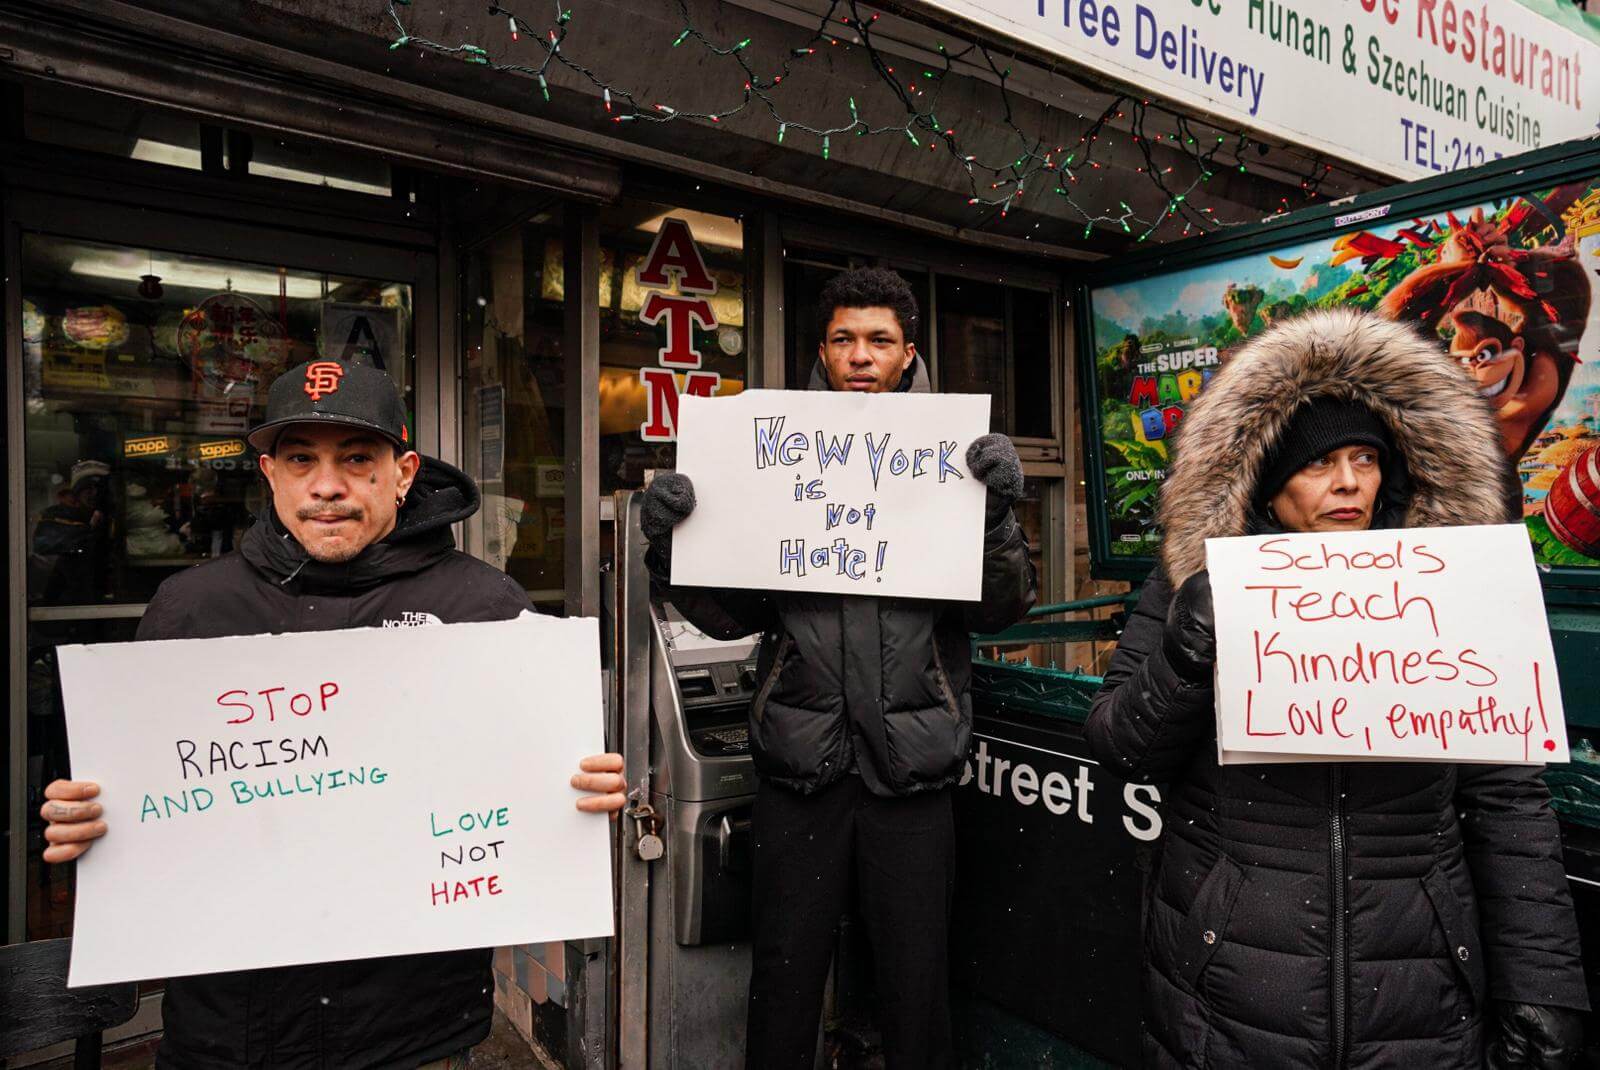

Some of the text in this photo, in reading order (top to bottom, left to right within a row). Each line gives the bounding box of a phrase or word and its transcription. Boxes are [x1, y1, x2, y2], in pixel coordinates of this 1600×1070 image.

[1037, 0, 1264, 116] ree Delivery
[1248, 0, 1541, 148] Hunan & Szechuan Cuisine
[1417, 0, 1581, 110] Restaurant
[341, 316, 386, 370] A
[636, 217, 719, 441] ATM
[1137, 362, 1156, 374] THE
[1157, 347, 1218, 371] SUPER
[754, 416, 964, 491] New York
[1126, 470, 1165, 481] ONLY IN
[794, 474, 827, 501] is
[779, 538, 888, 583] Hate!
[1259, 538, 1446, 574] Schools
[401, 611, 426, 621] THE
[1245, 581, 1439, 637] Teach
[1254, 630, 1498, 686] Kindness
[216, 682, 340, 725] STOP
[1246, 662, 1557, 761] Love, empathy!
[176, 735, 329, 779] RACISM
[140, 766, 388, 822] AND BULLYING
[431, 808, 509, 837] LOVE
[441, 841, 505, 868] NOT
[431, 876, 504, 906] HATE
